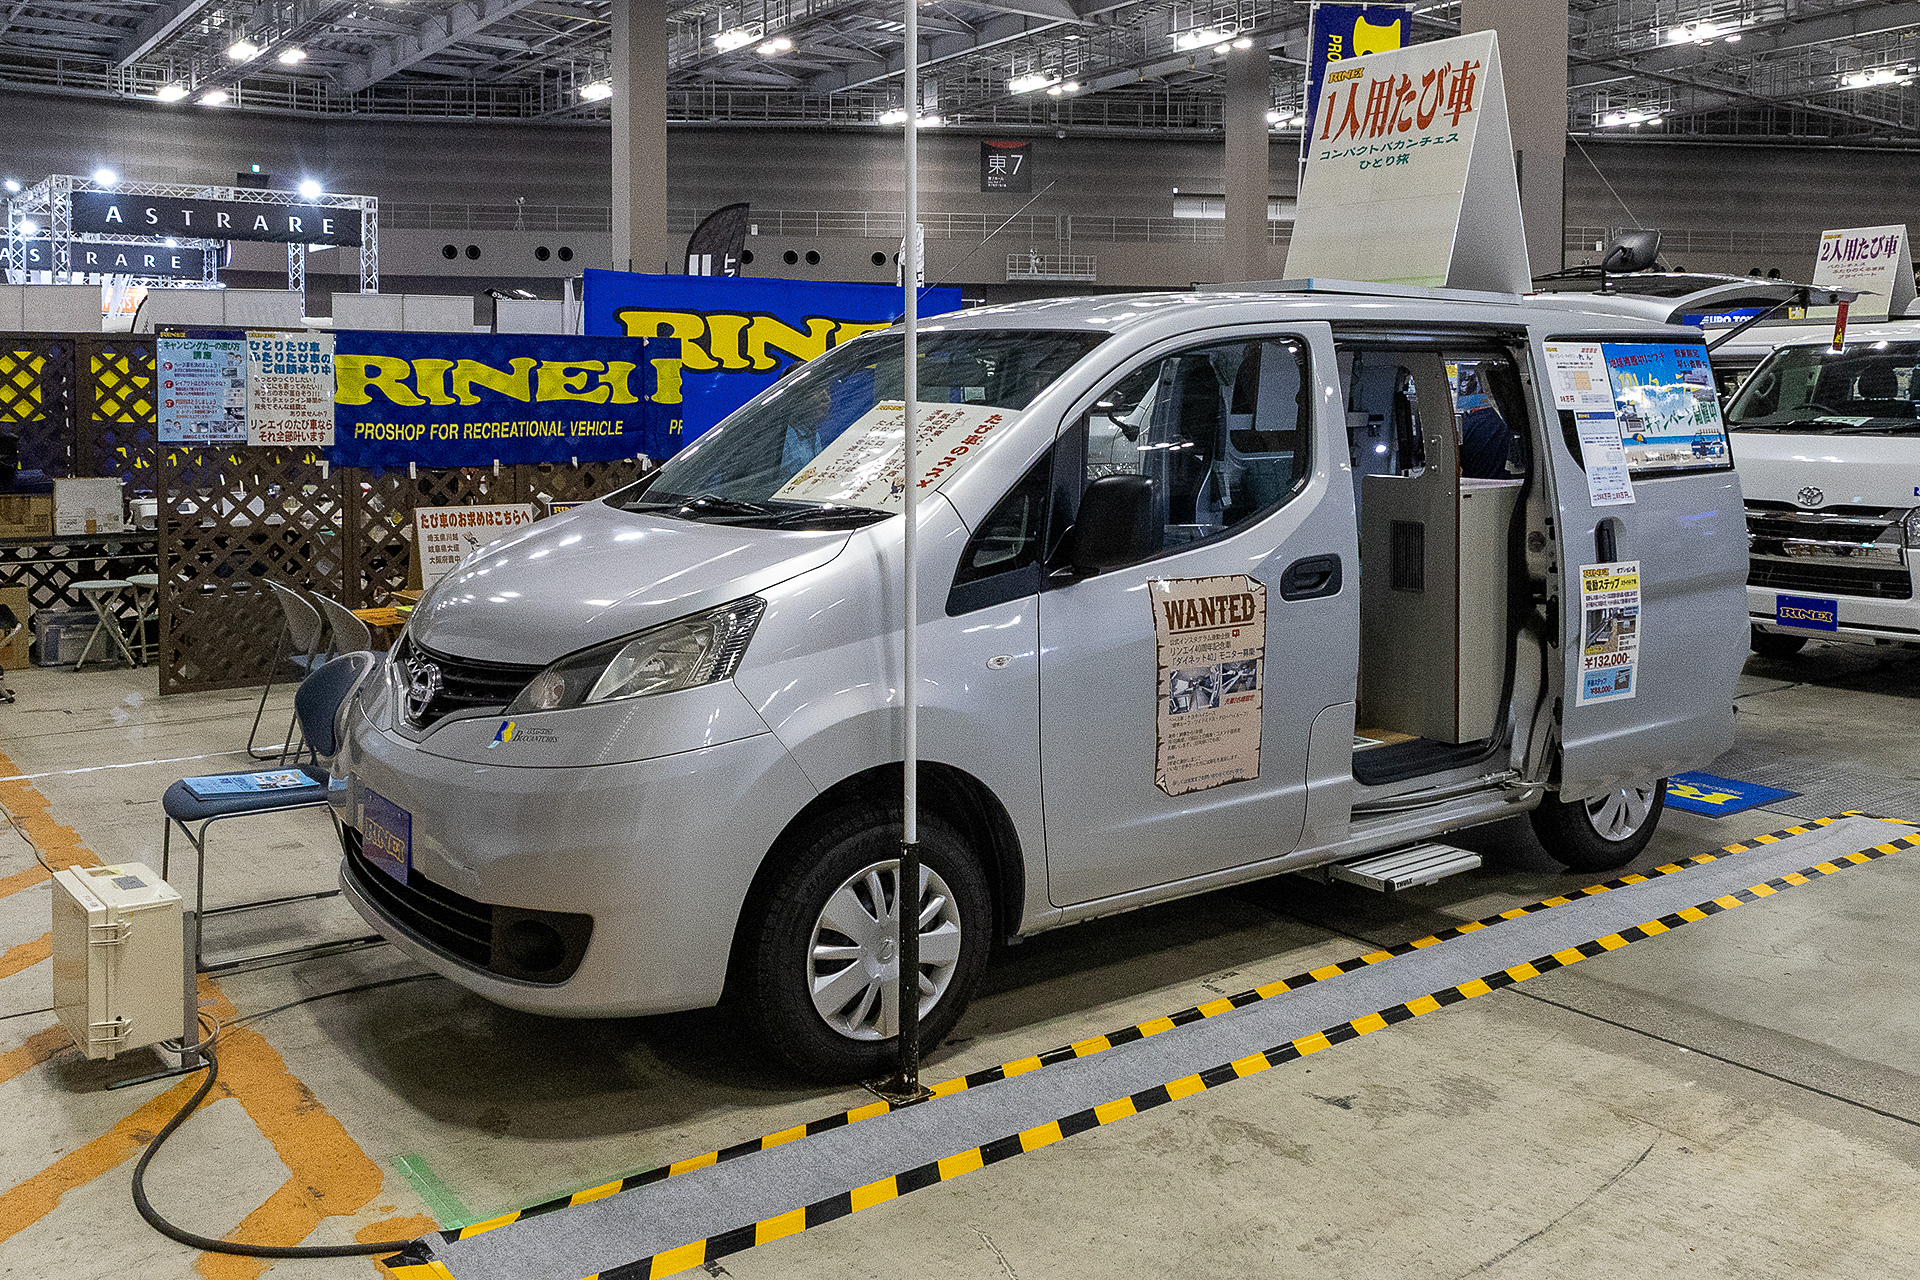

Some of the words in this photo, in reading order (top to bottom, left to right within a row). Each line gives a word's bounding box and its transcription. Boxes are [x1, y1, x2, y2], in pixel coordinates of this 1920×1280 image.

[1328, 67, 1365, 84] RINEI
[1319, 59, 1481, 143] 1人用たび車
[1319, 133, 1459, 161] コンパクトバカンチェス
[1359, 153, 1411, 170] ひとり旅
[105, 205, 335, 235] ASTRARE
[1821, 235, 1899, 262] 2人用たび車
[249, 341, 320, 352] ひとりたび車
[262, 363, 332, 375] ご相談承り中
[334, 354, 639, 406] RINEI
[250, 419, 333, 431] リンエイのたび車なら
[354, 422, 426, 441] PROSHOP
[430, 423, 459, 440] FOR
[463, 420, 565, 440] RECREATIONAL
[570, 420, 624, 437] VEHICLE
[258, 431, 326, 443] それ全部叶います
[420, 509, 531, 529] たび車のお求めはこちらへ
[427, 533, 459, 542] 埼玉県川越
[1585, 578, 1620, 592] 電動ステップ
[1163, 593, 1256, 630] WANTED
[1780, 607, 1833, 622] RINEI
